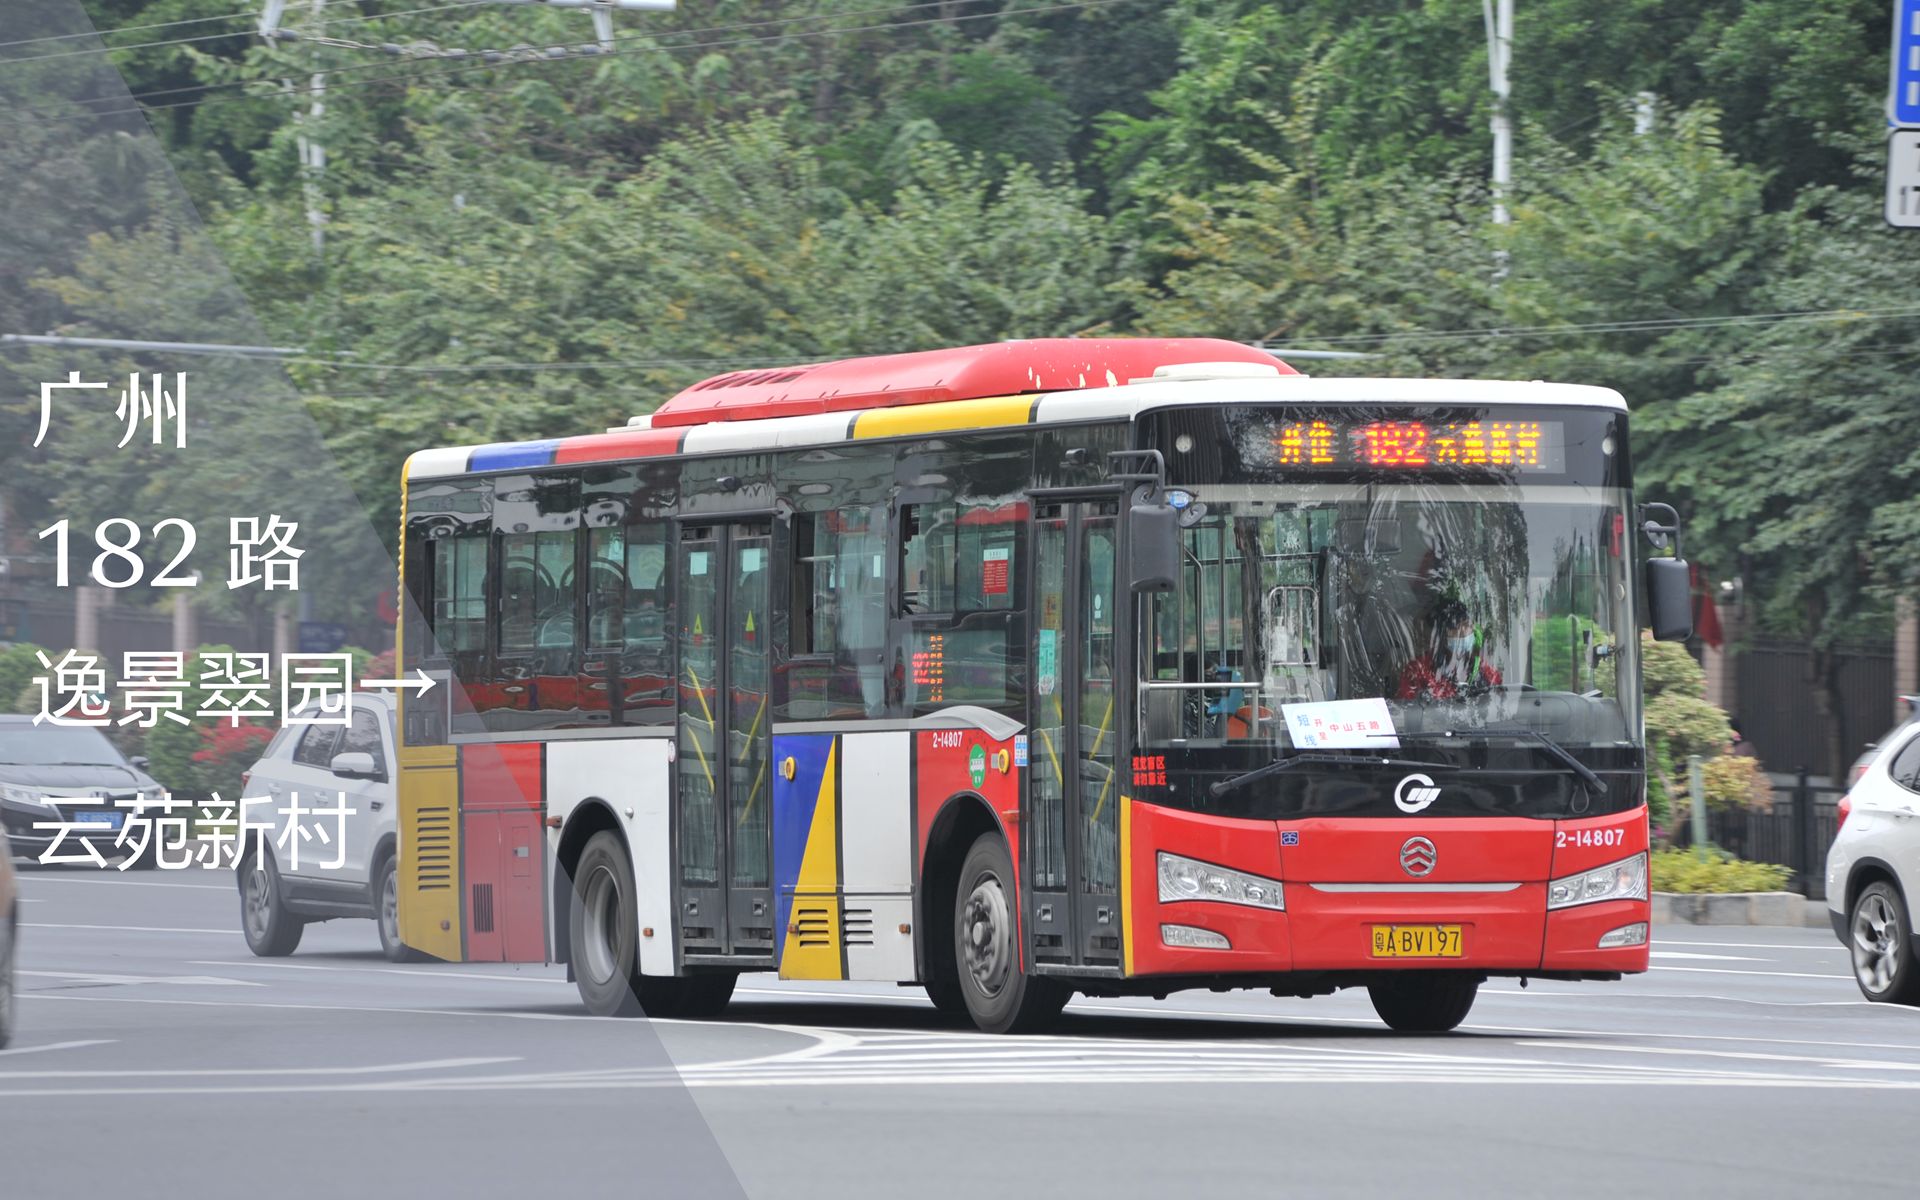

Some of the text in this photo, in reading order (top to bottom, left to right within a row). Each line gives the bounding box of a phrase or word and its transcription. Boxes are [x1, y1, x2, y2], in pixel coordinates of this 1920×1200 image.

[1365, 420, 1427, 464] 182
[932, 732, 963, 748] 2-14807
[1556, 829, 1625, 848] 2-14807
